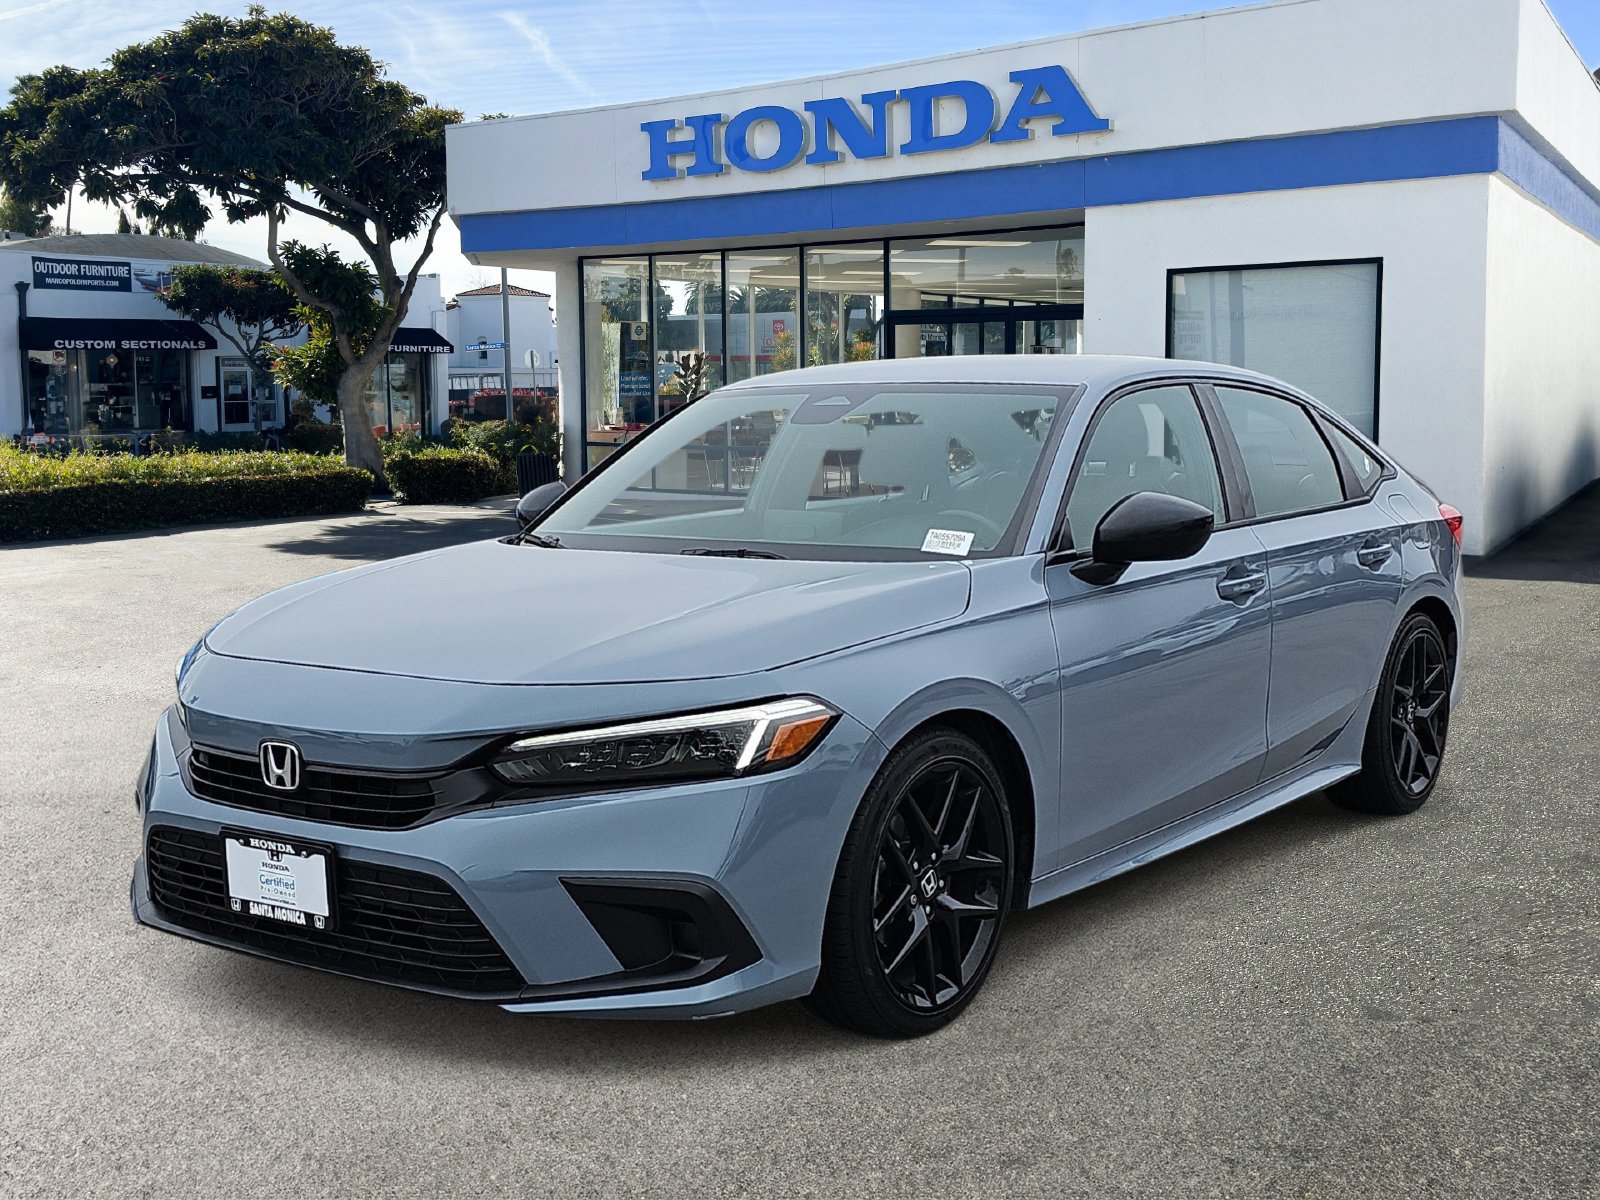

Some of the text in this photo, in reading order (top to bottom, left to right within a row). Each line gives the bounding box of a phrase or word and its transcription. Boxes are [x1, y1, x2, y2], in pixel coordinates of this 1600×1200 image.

[640, 64, 1113, 181] HONDA
[34, 261, 130, 277] OUTDOOR FURNITURE
[45, 277, 119, 287] MARCOPOLOIMPORTS.COM
[54, 339, 206, 349] CUSTOM SECTIONALS
[388, 344, 451, 353] FURNITURE
[249, 838, 295, 854] HONDA
[261, 861, 290, 873] HONDA
[259, 874, 295, 891] Certified
[260, 886, 296, 898] Pre-Owned
[249, 901, 307, 926] SANTA MONICA
